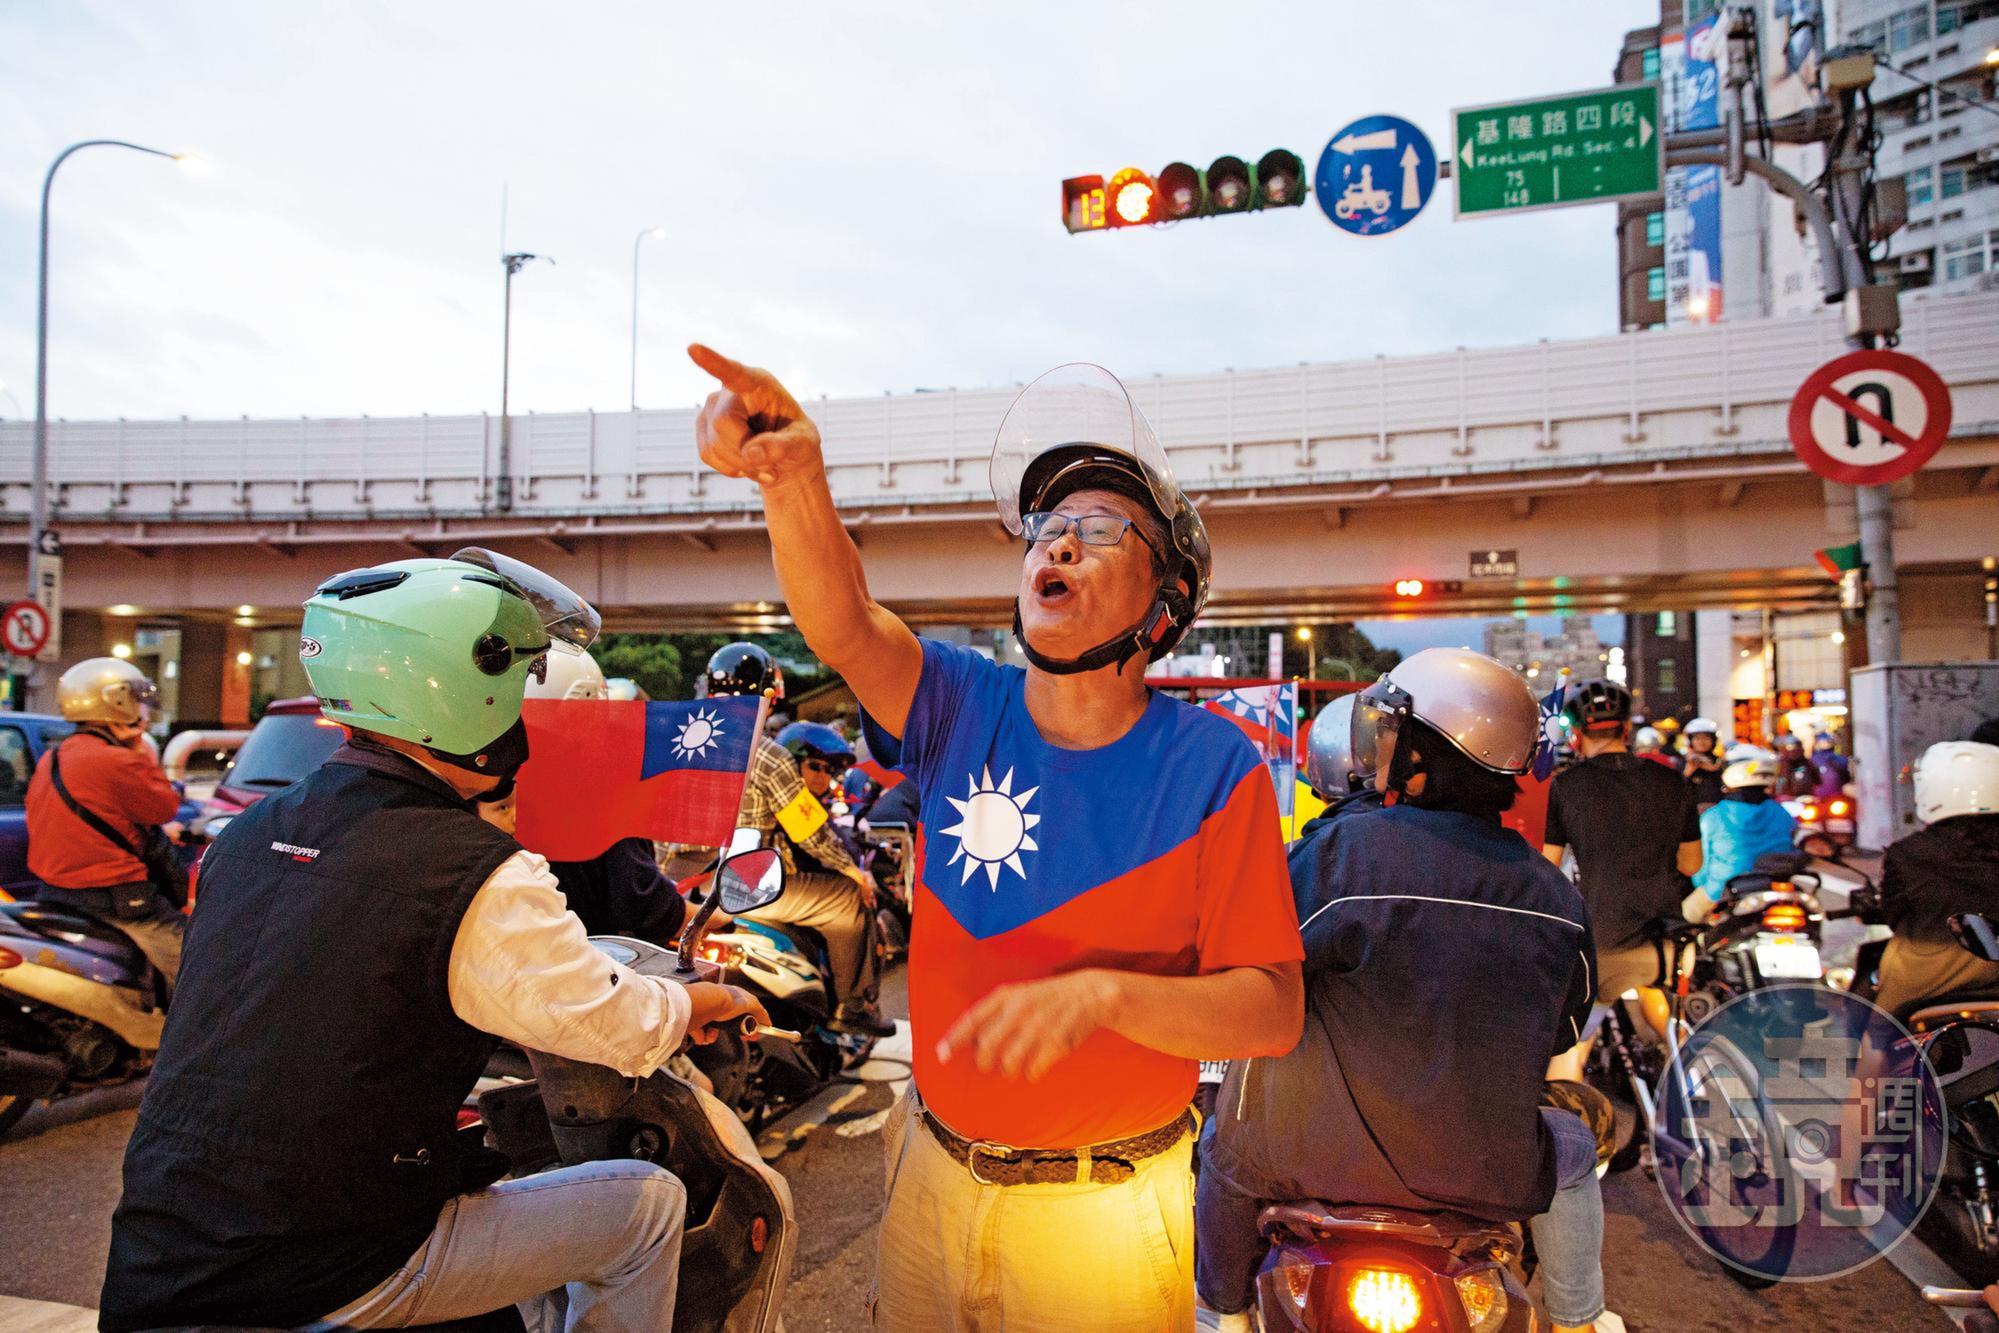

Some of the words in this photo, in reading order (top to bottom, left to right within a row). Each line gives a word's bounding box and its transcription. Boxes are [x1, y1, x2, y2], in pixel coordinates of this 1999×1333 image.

[1476, 101, 1636, 146] 基隆路四段
[1624, 136, 1636, 149] 4
[1505, 169, 1525, 188] 75
[1081, 188, 1105, 227] 13
